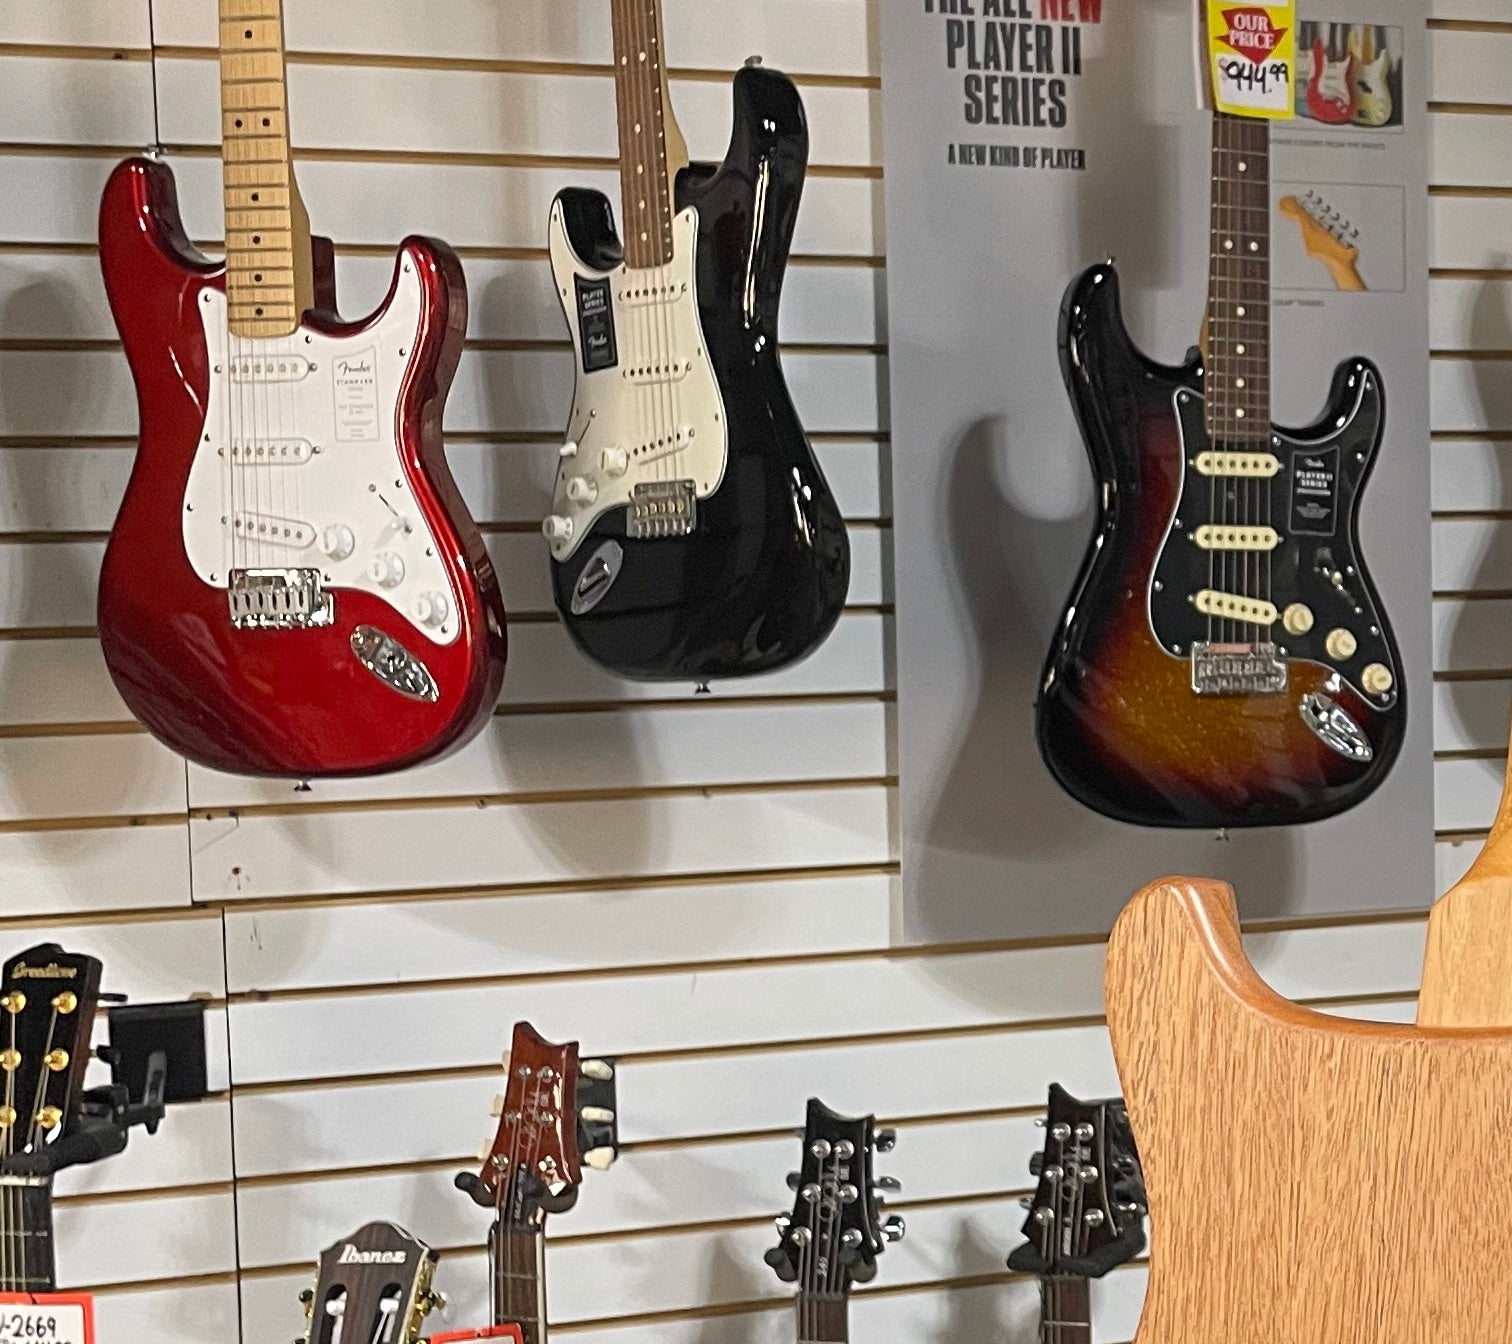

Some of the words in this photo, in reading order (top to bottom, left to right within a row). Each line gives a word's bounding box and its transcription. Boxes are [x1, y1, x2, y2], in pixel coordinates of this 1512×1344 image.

[1233, 13, 1269, 31] OUR
[946, 19, 1054, 75] PLAYER
[1061, 26, 1082, 76] II
[1229, 29, 1275, 50] PRICE
[964, 73, 1068, 128] SERIES
[948, 143, 956, 165] A
[959, 143, 987, 166] NEW
[989, 145, 1020, 168] KIND
[1022, 146, 1037, 168] OF
[1040, 147, 1086, 171] PLAYER
[337, 1244, 407, 1264] Ibanez
